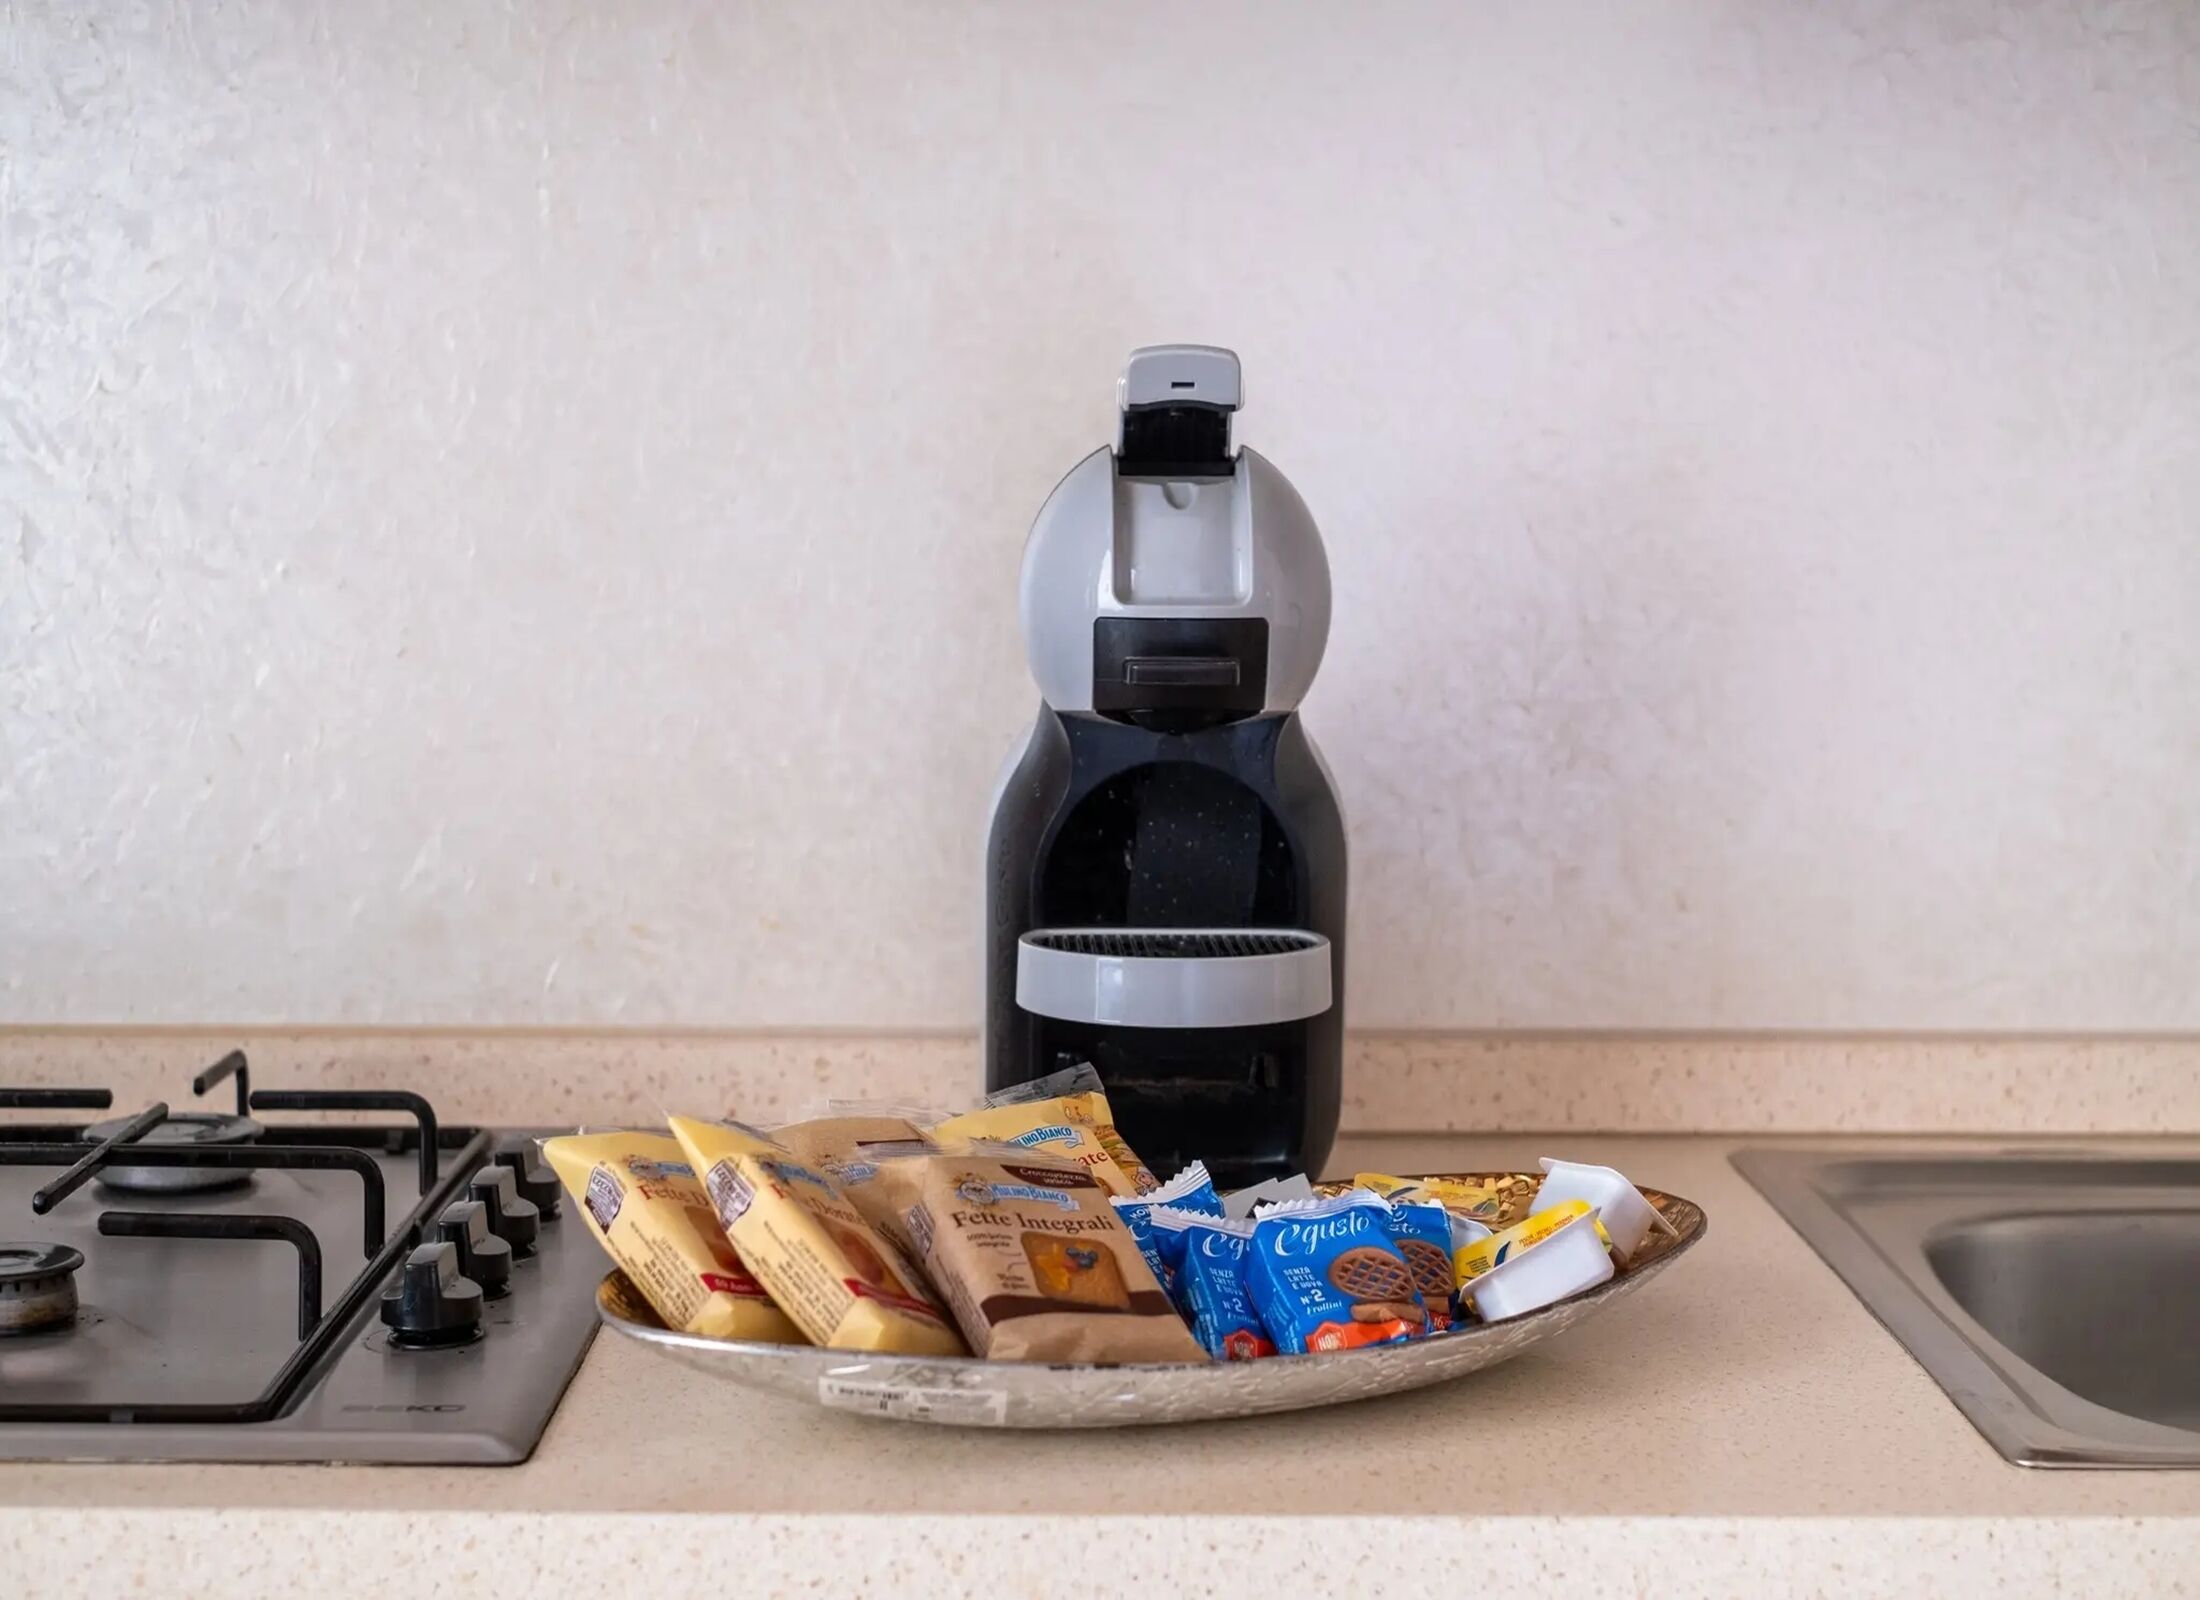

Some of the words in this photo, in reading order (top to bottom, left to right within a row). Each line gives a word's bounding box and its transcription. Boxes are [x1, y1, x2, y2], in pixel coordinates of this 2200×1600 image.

[1036, 1127, 1072, 1140] BIANCO
[1074, 1150, 1108, 1169] ate
[991, 1184, 1029, 1199] MULINO
[1029, 1186, 1069, 1202] BIANCO
[951, 1211, 1012, 1228] Fette
[1015, 1212, 1114, 1235] Integrali
[1283, 1266, 1311, 1276] SENZA
